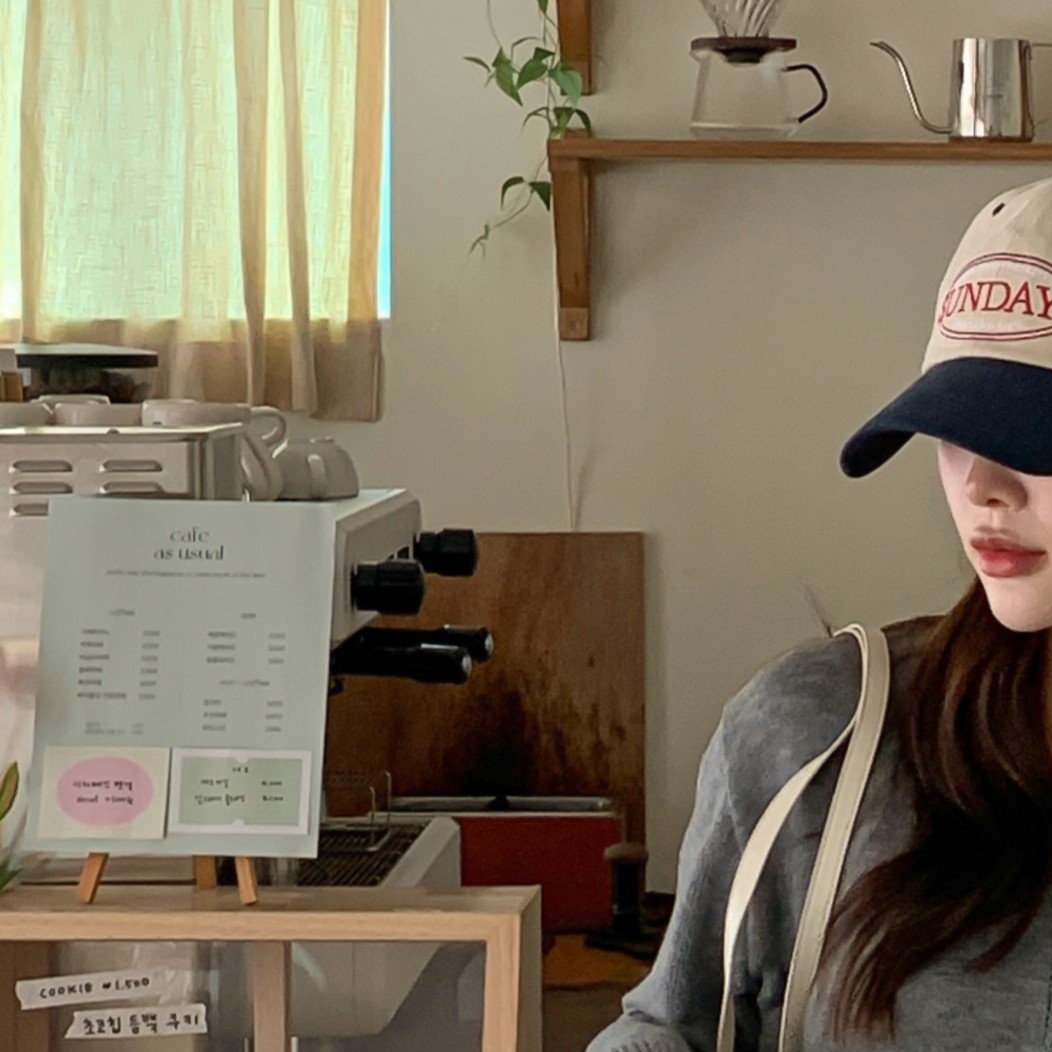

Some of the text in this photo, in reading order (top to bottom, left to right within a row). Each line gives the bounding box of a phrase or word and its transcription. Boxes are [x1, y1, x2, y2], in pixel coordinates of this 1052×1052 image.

[169, 526, 210, 543] cafe
[153, 544, 225, 561] as usual
[39, 982, 93, 999] COOKIE
